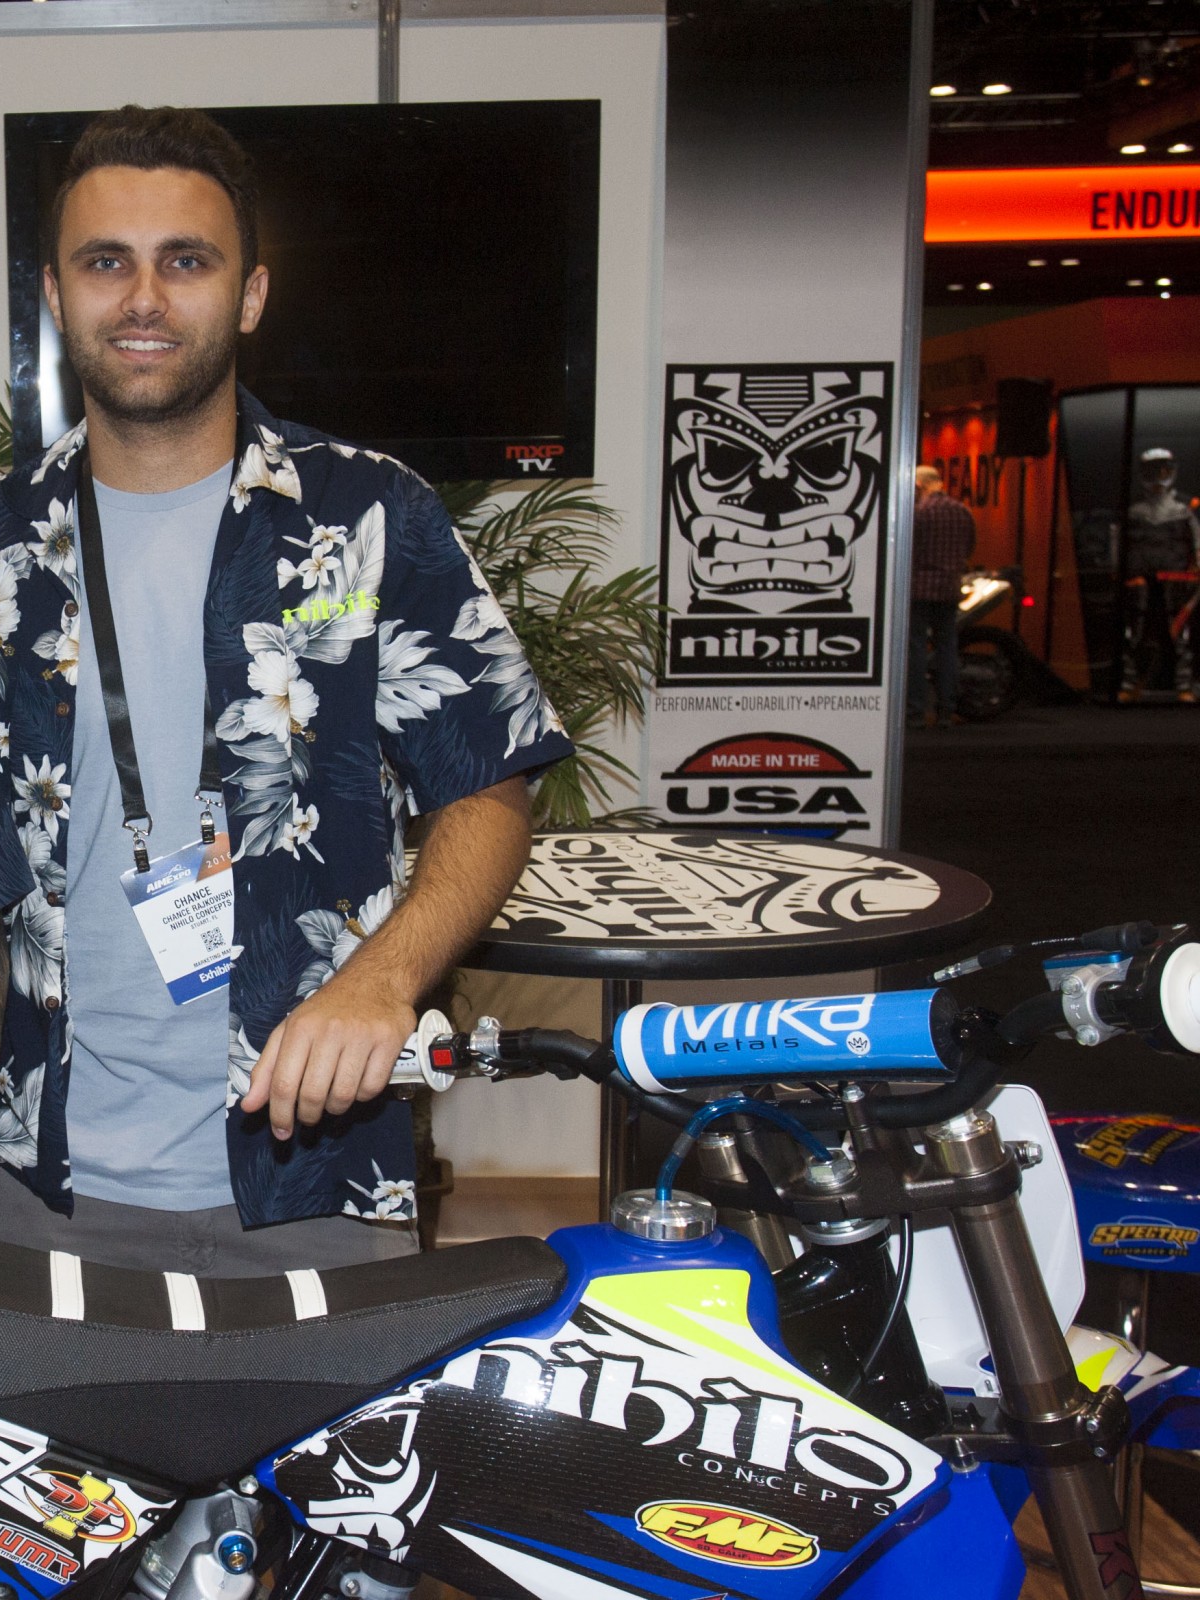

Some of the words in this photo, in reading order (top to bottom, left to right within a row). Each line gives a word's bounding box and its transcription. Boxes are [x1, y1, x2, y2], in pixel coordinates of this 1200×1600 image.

[1090, 189, 1200, 231] ENDU
[517, 458, 552, 472] TV
[281, 589, 381, 623] nihilo
[680, 627, 862, 660] nihilo
[655, 696, 733, 712] PERFORMANCE
[741, 696, 803, 711] DURABILITY
[809, 696, 881, 711] APPEARANCE
[711, 754, 761, 768] MADE
[765, 754, 783, 767] IN
[788, 753, 820, 767] THE
[666, 786, 867, 815] USA
[162, 907, 191, 925] CHANCE
[192, 889, 233, 912] RAJKOWSKI
[174, 886, 212, 909] CHANCE
[170, 915, 194, 931] NIHILO
[195, 900, 232, 920] CONCEPTS
[682, 1036, 800, 1055] Metals
[1091, 1225, 1199, 1249] SPECTRO
[442, 1339, 907, 1491] nihilo
[677, 1452, 891, 1517] CONCEPTS
[640, 1507, 814, 1556] FMF
[21, 1560, 69, 1585] PERFORMANCE
